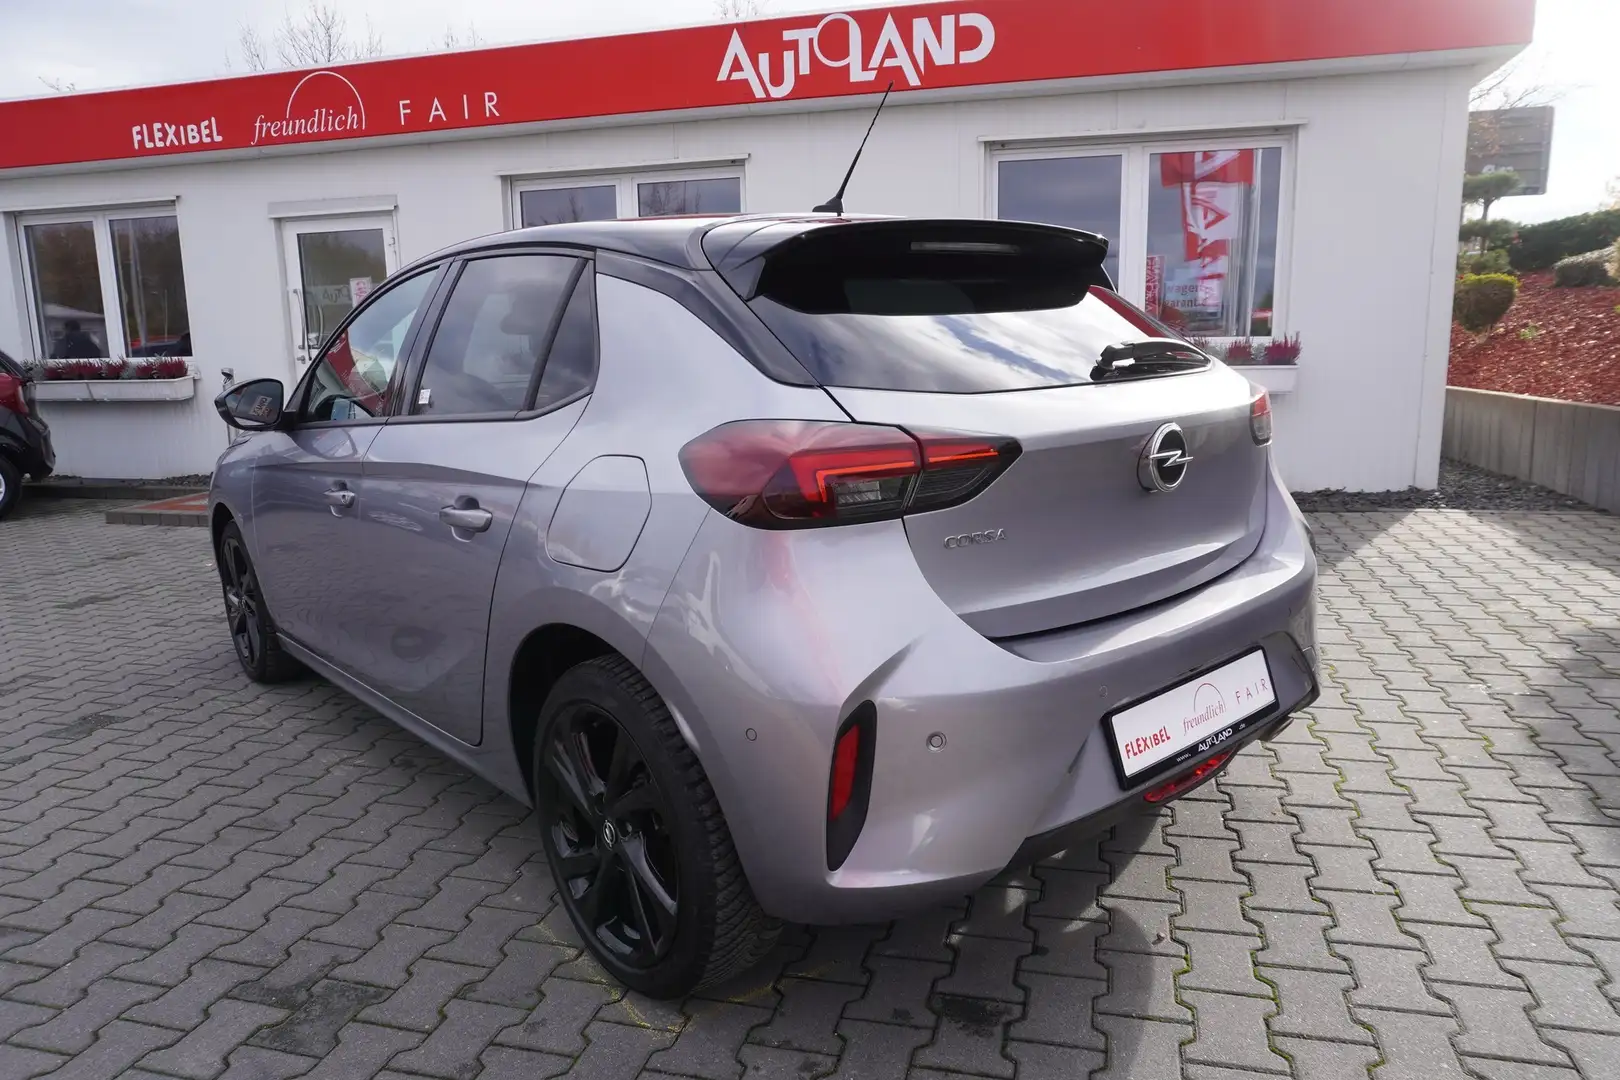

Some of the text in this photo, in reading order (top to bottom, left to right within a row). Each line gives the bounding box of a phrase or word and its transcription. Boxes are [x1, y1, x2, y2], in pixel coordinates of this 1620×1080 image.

[716, 12, 996, 99] AUTOLAND
[131, 91, 500, 150] FLEXIBEL freundlich FAIR
[944, 528, 1006, 549] CORSA
[1124, 678, 1268, 760] FLEXIBEL freundlich FAIR
[1198, 728, 1233, 752] AUTOLAND
